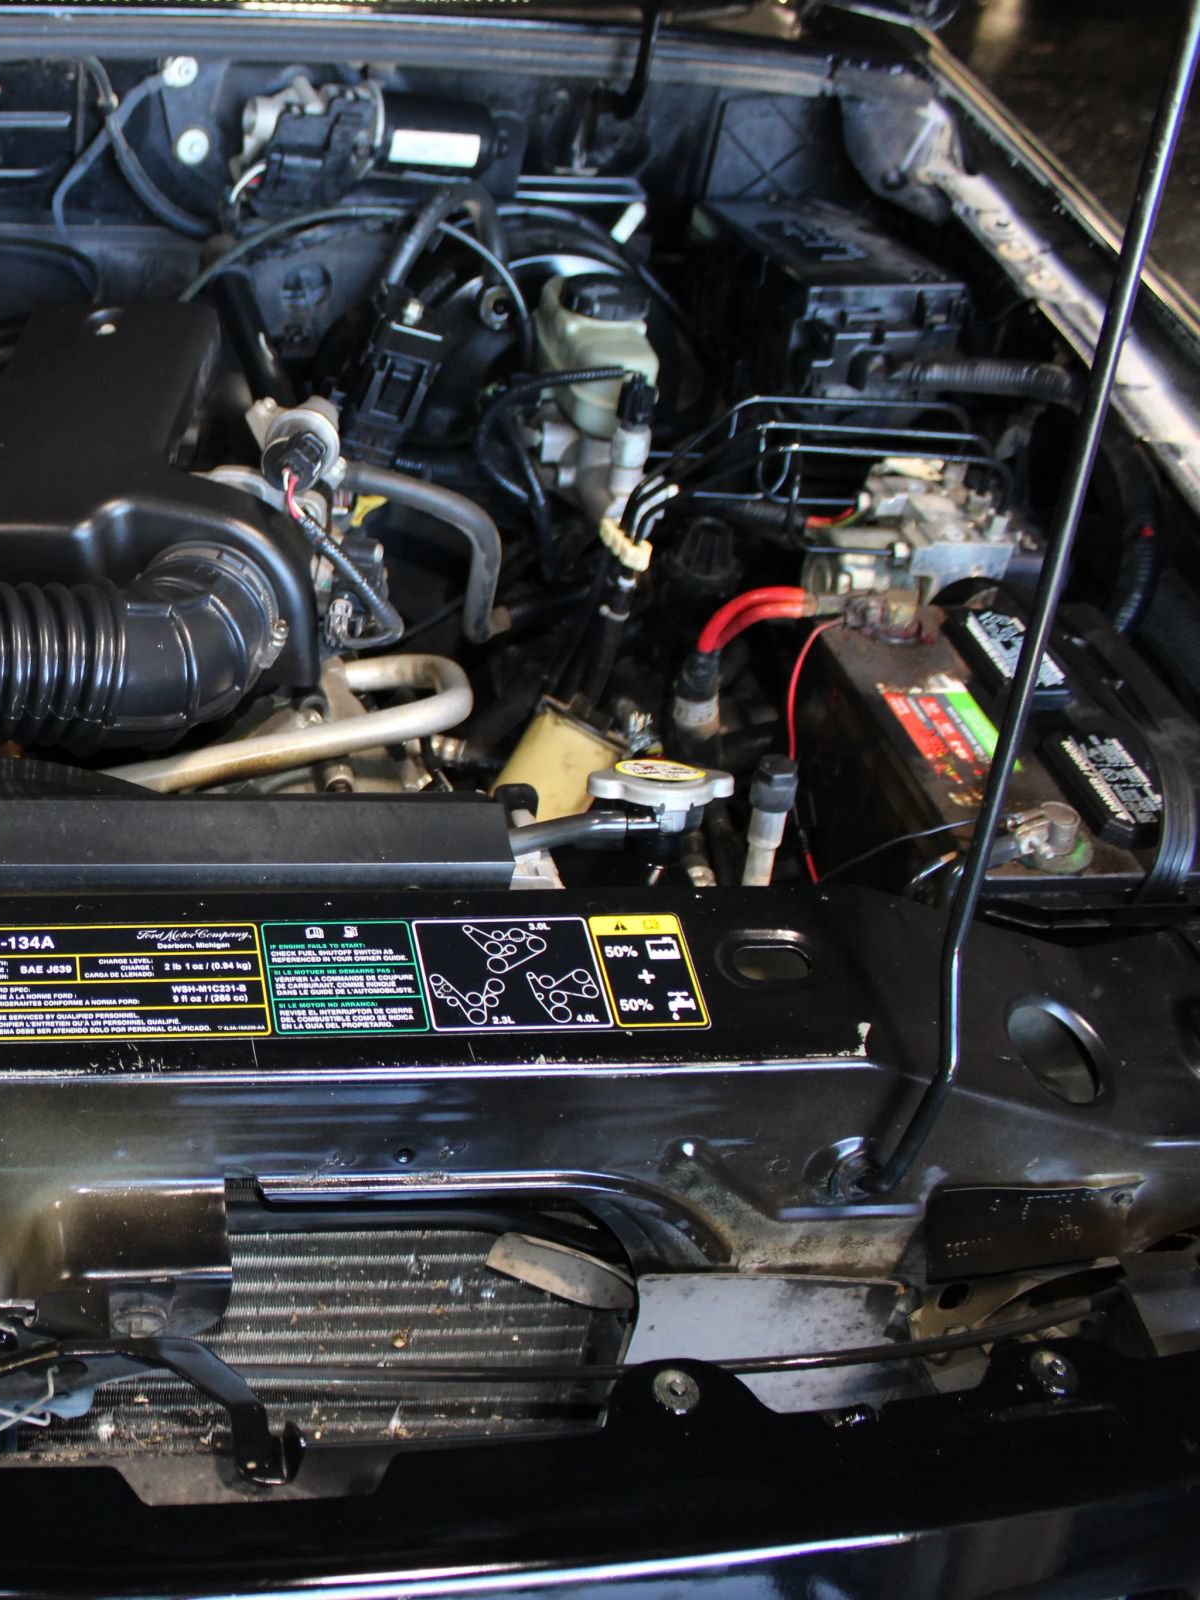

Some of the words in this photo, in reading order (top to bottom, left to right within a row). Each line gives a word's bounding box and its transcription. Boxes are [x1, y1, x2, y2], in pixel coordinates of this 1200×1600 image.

[137, 930, 164, 939] Ford
[160, 929, 196, 941] Motor
[605, 945, 638, 957] 50%
[20, 965, 43, 974] SAE
[46, 965, 72, 973] J639
[173, 962, 182, 970] lb
[211, 961, 234, 970] (0.94
[236, 961, 251, 971] kg)
[172, 985, 246, 993] WSH-M1C231-B
[173, 995, 178, 1003] 9
[233, 994, 248, 1003] cc)
[619, 999, 654, 1011] 50%
[492, 1016, 515, 1024] 2.3L
[576, 1014, 599, 1022] 4.0L
